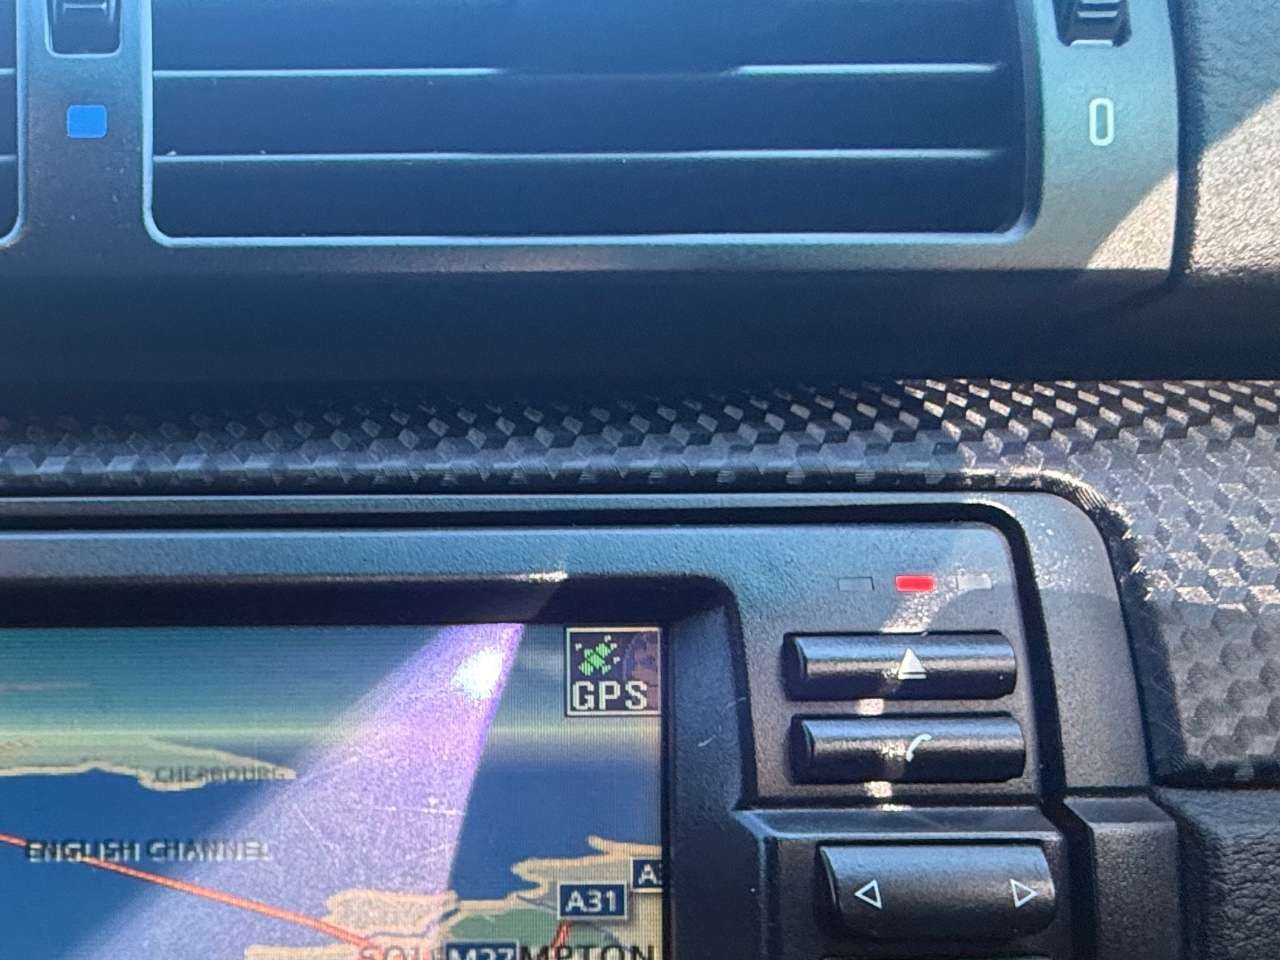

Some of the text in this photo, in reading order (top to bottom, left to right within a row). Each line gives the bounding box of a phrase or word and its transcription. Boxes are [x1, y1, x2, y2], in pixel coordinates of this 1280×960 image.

[572, 680, 648, 710] GPS
[26, 840, 273, 864] ENGLISH CHANNEL
[565, 890, 617, 914] A31
